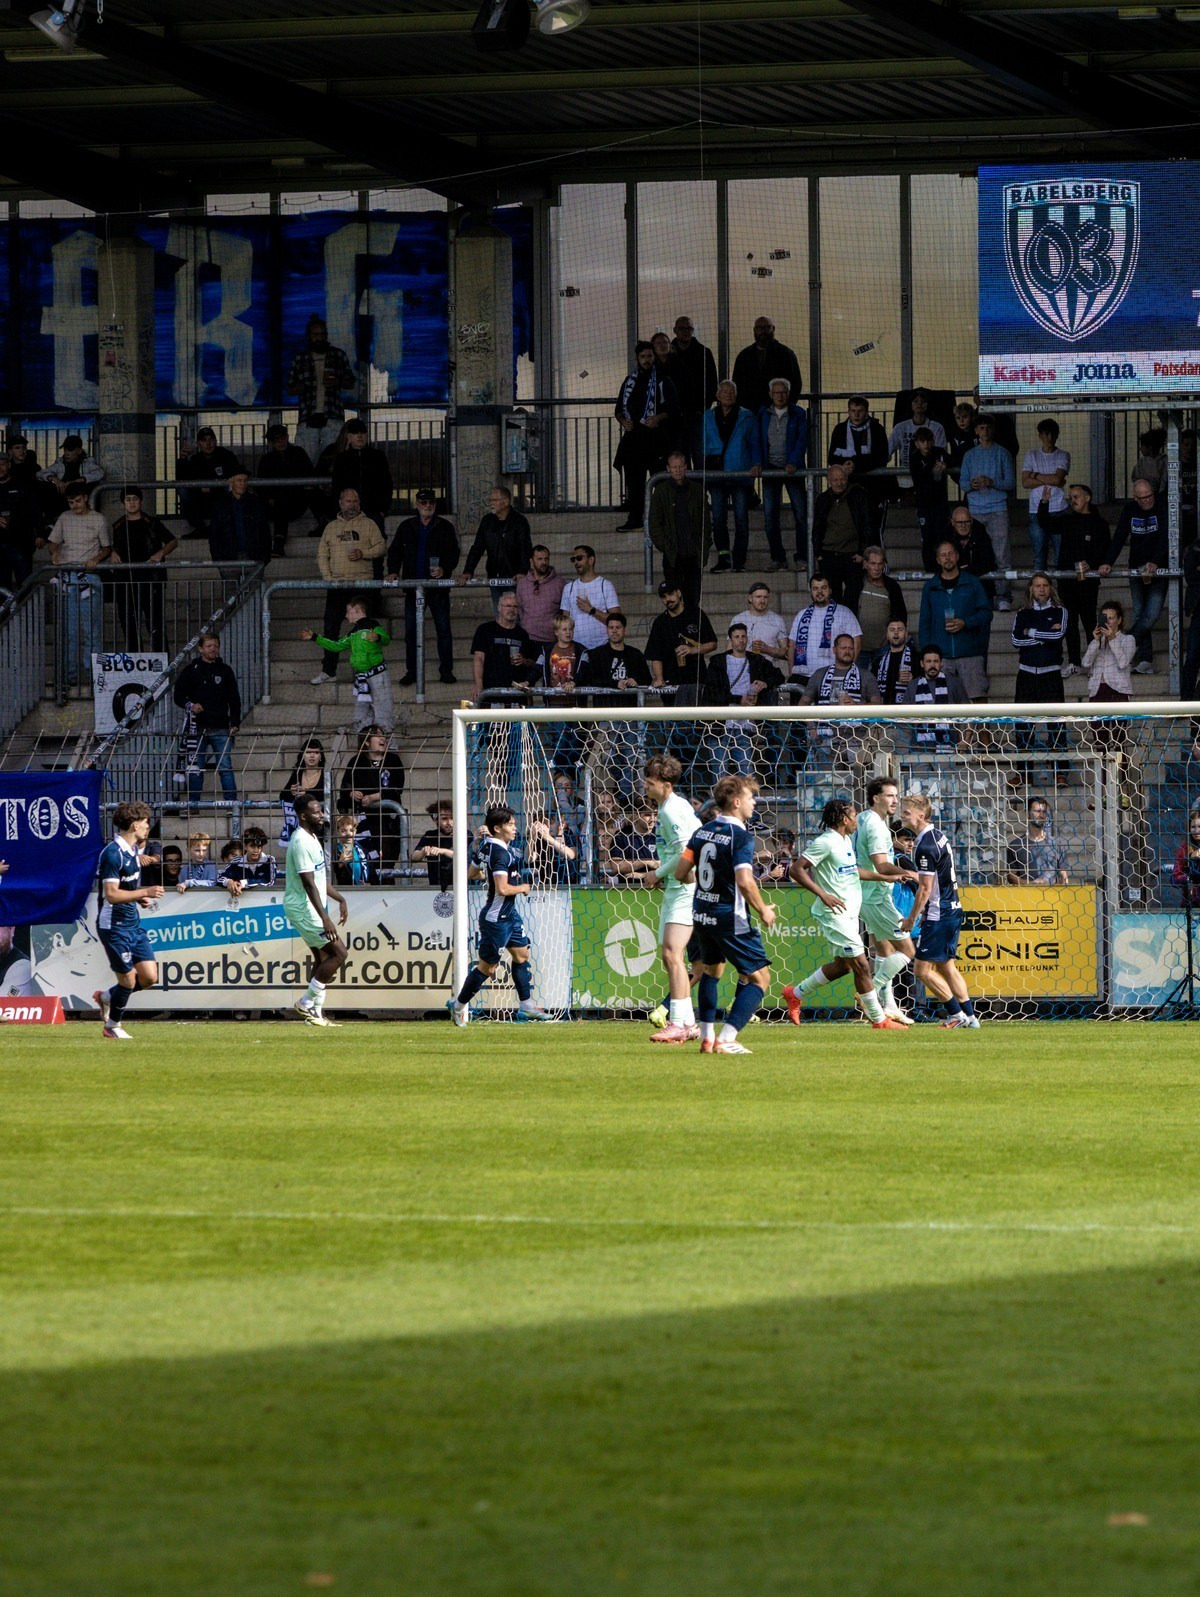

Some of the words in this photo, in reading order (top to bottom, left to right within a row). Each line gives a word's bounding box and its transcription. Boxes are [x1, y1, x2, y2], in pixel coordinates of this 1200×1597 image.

[1011, 182, 1133, 204] BABELSBERG
[1026, 220, 1115, 293] 03
[994, 365, 1056, 383] Katjes
[698, 842, 717, 892] 6
[148, 920, 206, 945] ewirb
[212, 914, 259, 938] dich
[264, 910, 300, 936] jet
[999, 915, 1054, 926] HAUS
